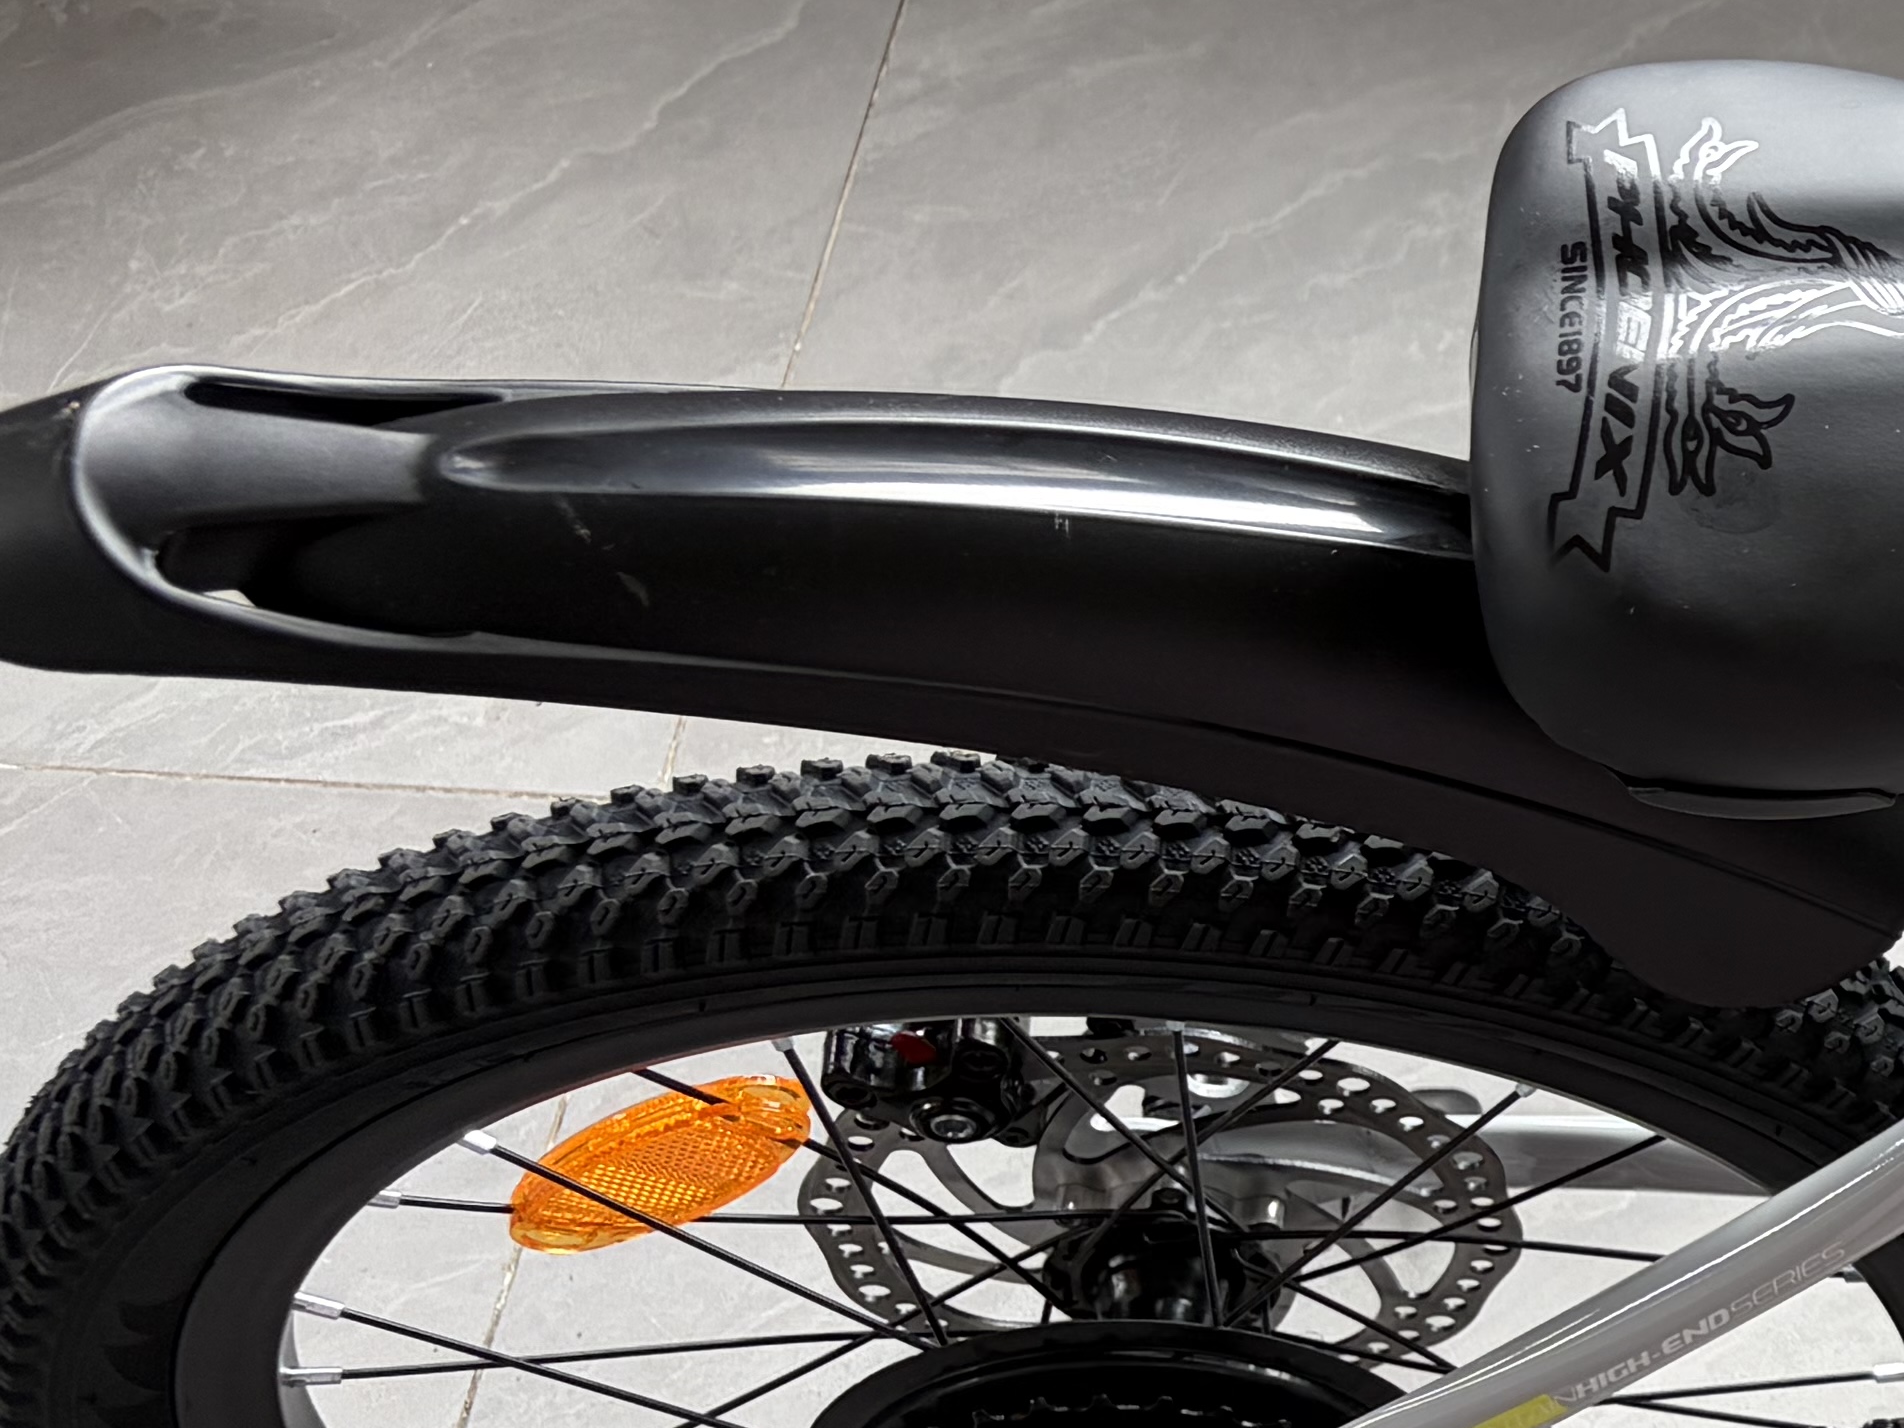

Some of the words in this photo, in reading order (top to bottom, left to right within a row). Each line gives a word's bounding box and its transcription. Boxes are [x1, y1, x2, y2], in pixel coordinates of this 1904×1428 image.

[1594, 149, 1652, 497] PHOENIX
[1577, 1308, 1730, 1400] HIGH-END
[1730, 1243, 1846, 1317] SERIES
